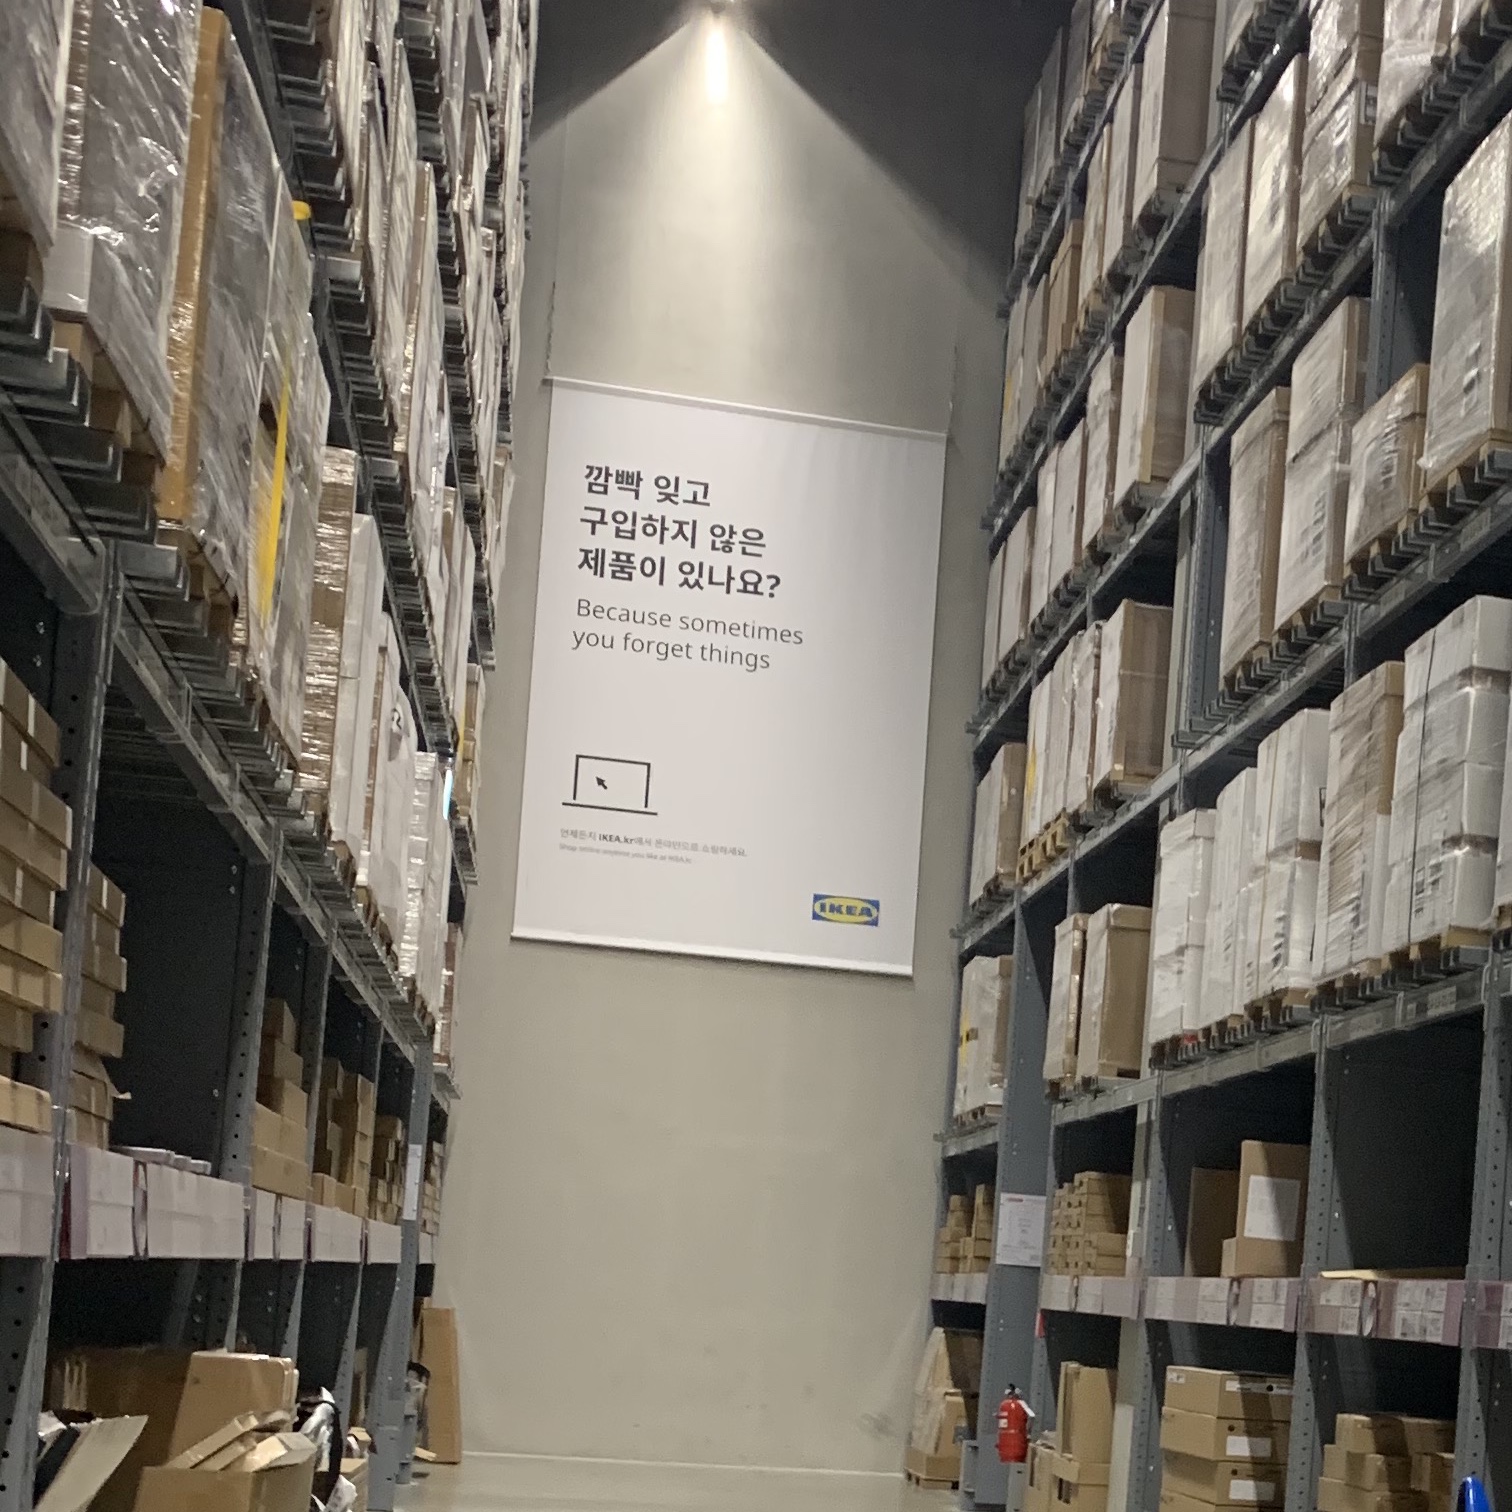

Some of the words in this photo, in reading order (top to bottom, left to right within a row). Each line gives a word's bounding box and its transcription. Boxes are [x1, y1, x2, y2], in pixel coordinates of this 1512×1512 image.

[584, 465, 644, 500] 깜빡
[653, 475, 712, 507] 잊고
[580, 506, 698, 549] 구입하지
[709, 524, 767, 558] 않은
[577, 548, 666, 587] 제품이
[678, 561, 782, 599] 있나요?
[577, 598, 672, 628] Because
[679, 616, 804, 645] sometimes
[572, 629, 615, 650] you
[623, 632, 693, 662] forget
[700, 643, 771, 673] things
[820, 902, 873, 917] IKEA
